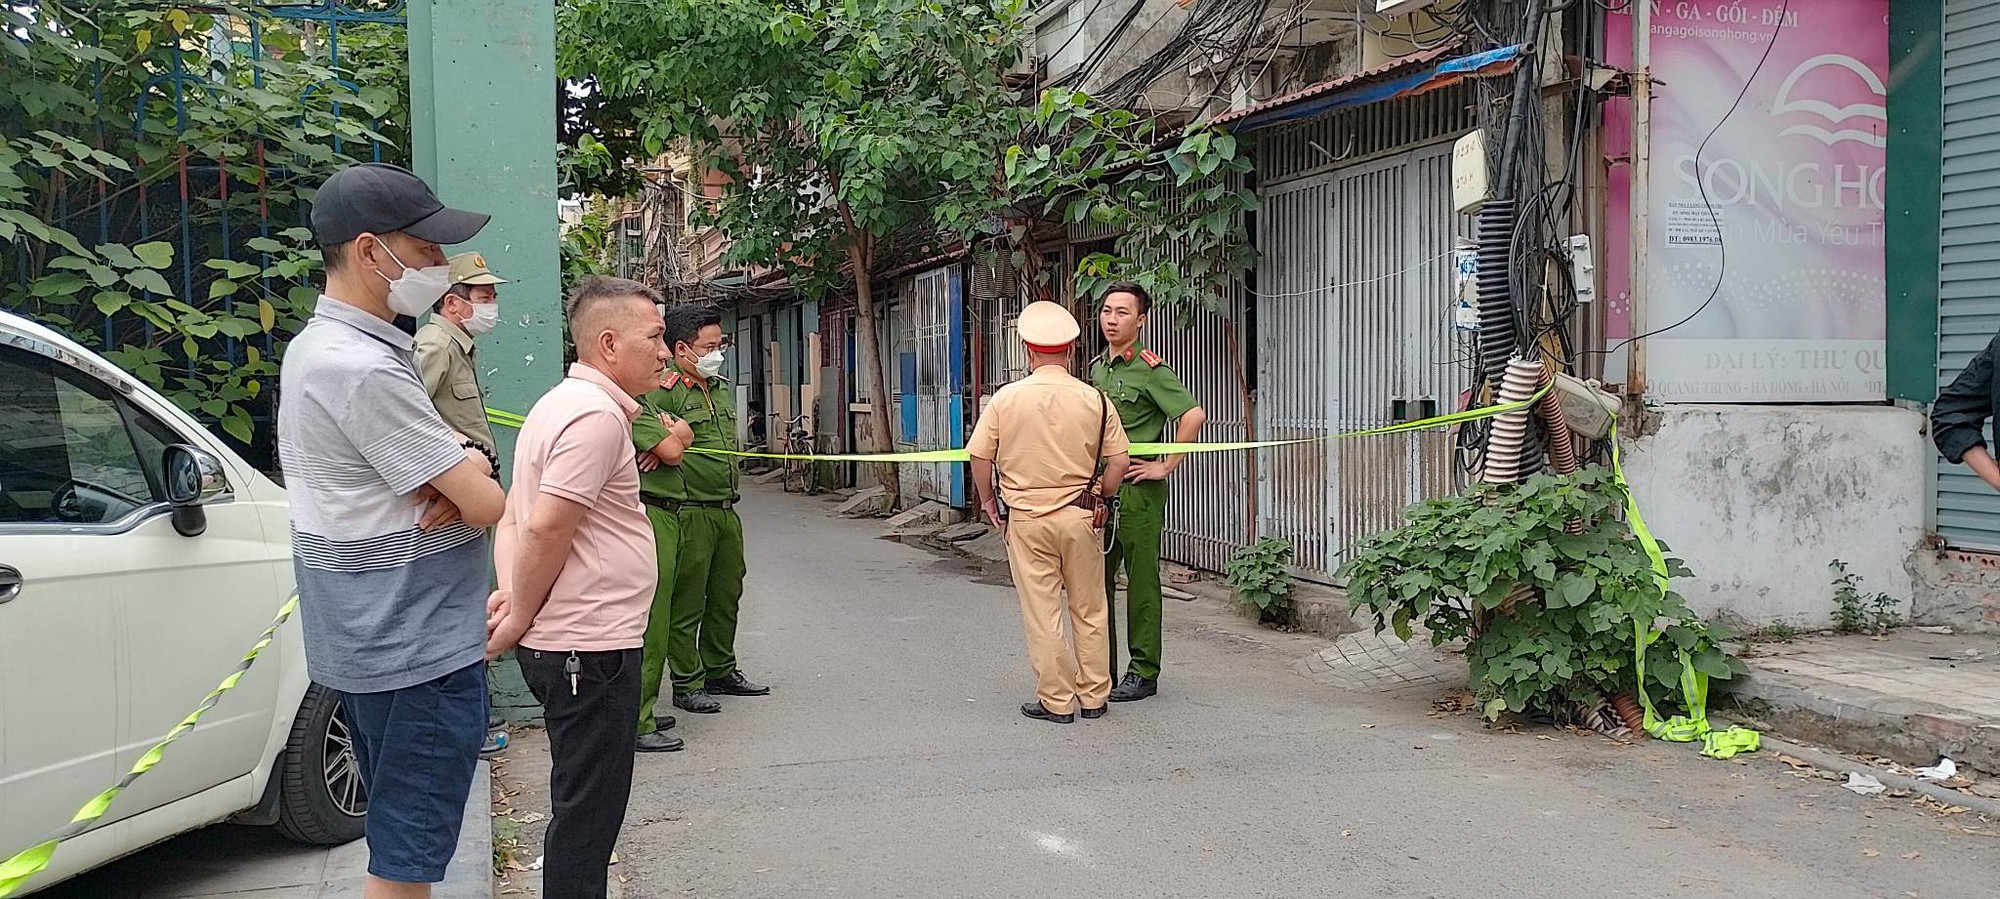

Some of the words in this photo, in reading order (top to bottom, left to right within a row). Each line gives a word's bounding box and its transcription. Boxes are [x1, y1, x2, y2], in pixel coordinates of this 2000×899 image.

[1676, 2, 1701, 20] GA
[1716, 0, 1747, 24] GỐI
[1650, 24, 1774, 44] angagoisonghong.vn
[1672, 154, 1823, 212] SONG
[1815, 218, 1859, 247] Yêu
[1750, 346, 1786, 369] LÝ:
[1795, 348, 1847, 369] THU
[1658, 381, 1699, 397] QUANG
[1702, 381, 1741, 394] TRUNG
